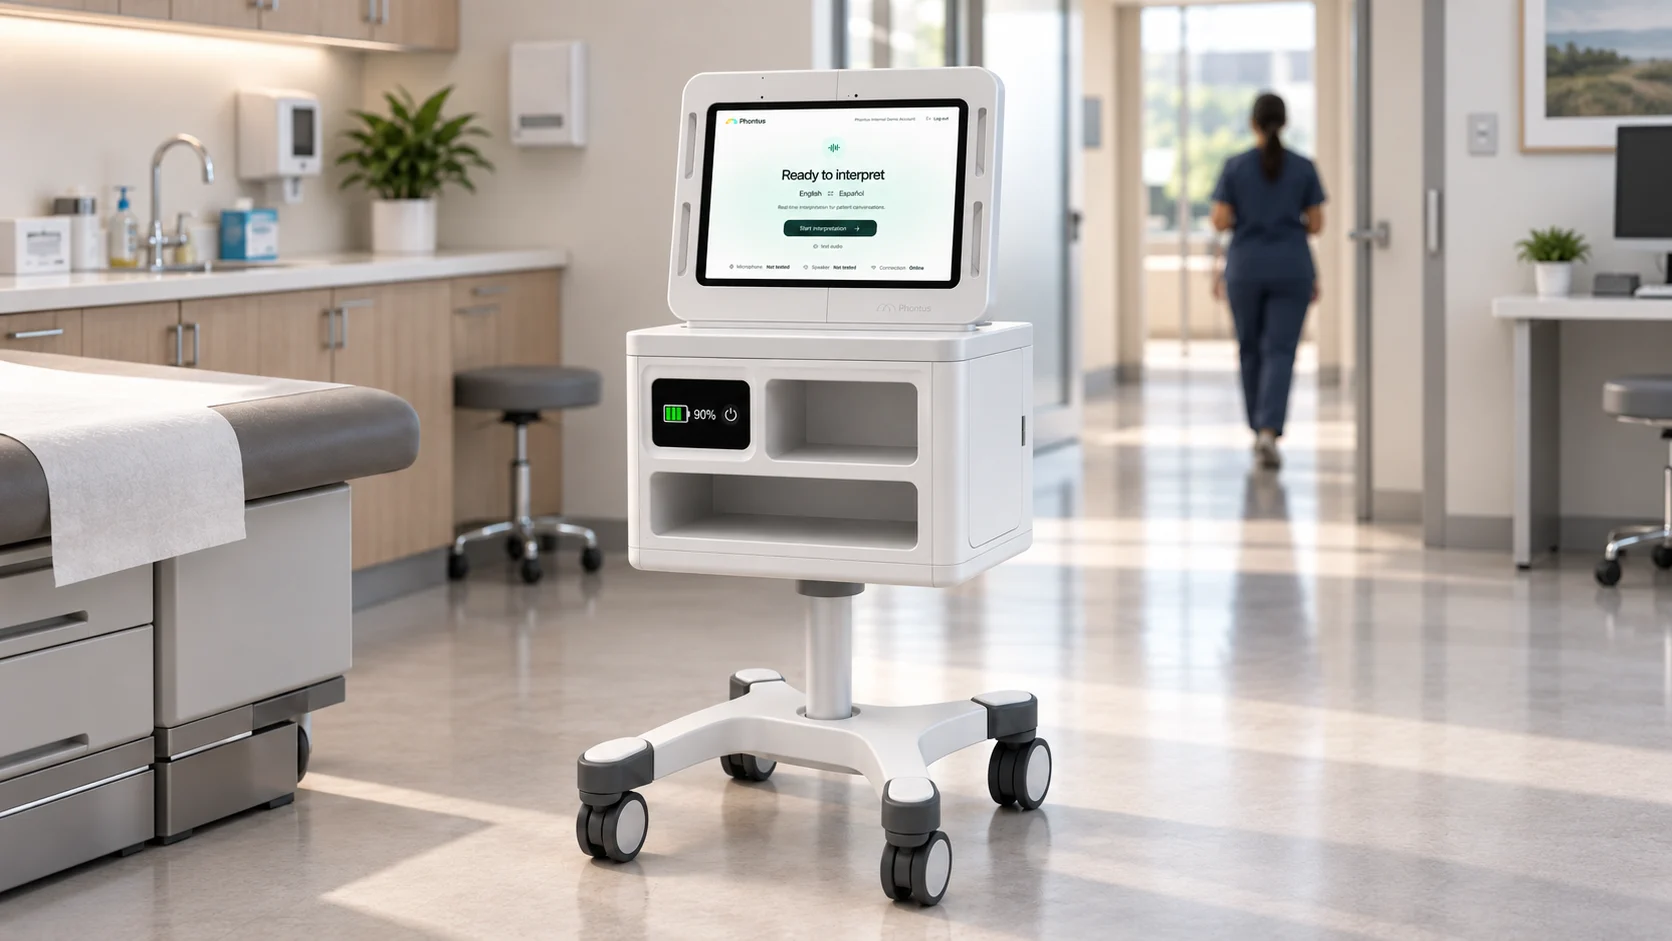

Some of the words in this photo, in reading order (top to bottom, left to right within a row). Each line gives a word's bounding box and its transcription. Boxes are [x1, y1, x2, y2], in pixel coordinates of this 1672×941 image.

[782, 169, 819, 183] Ready
[821, 170, 833, 180] to
[836, 169, 885, 182] interpret
[899, 304, 931, 312] Phontus
[694, 409, 716, 420] 90%
